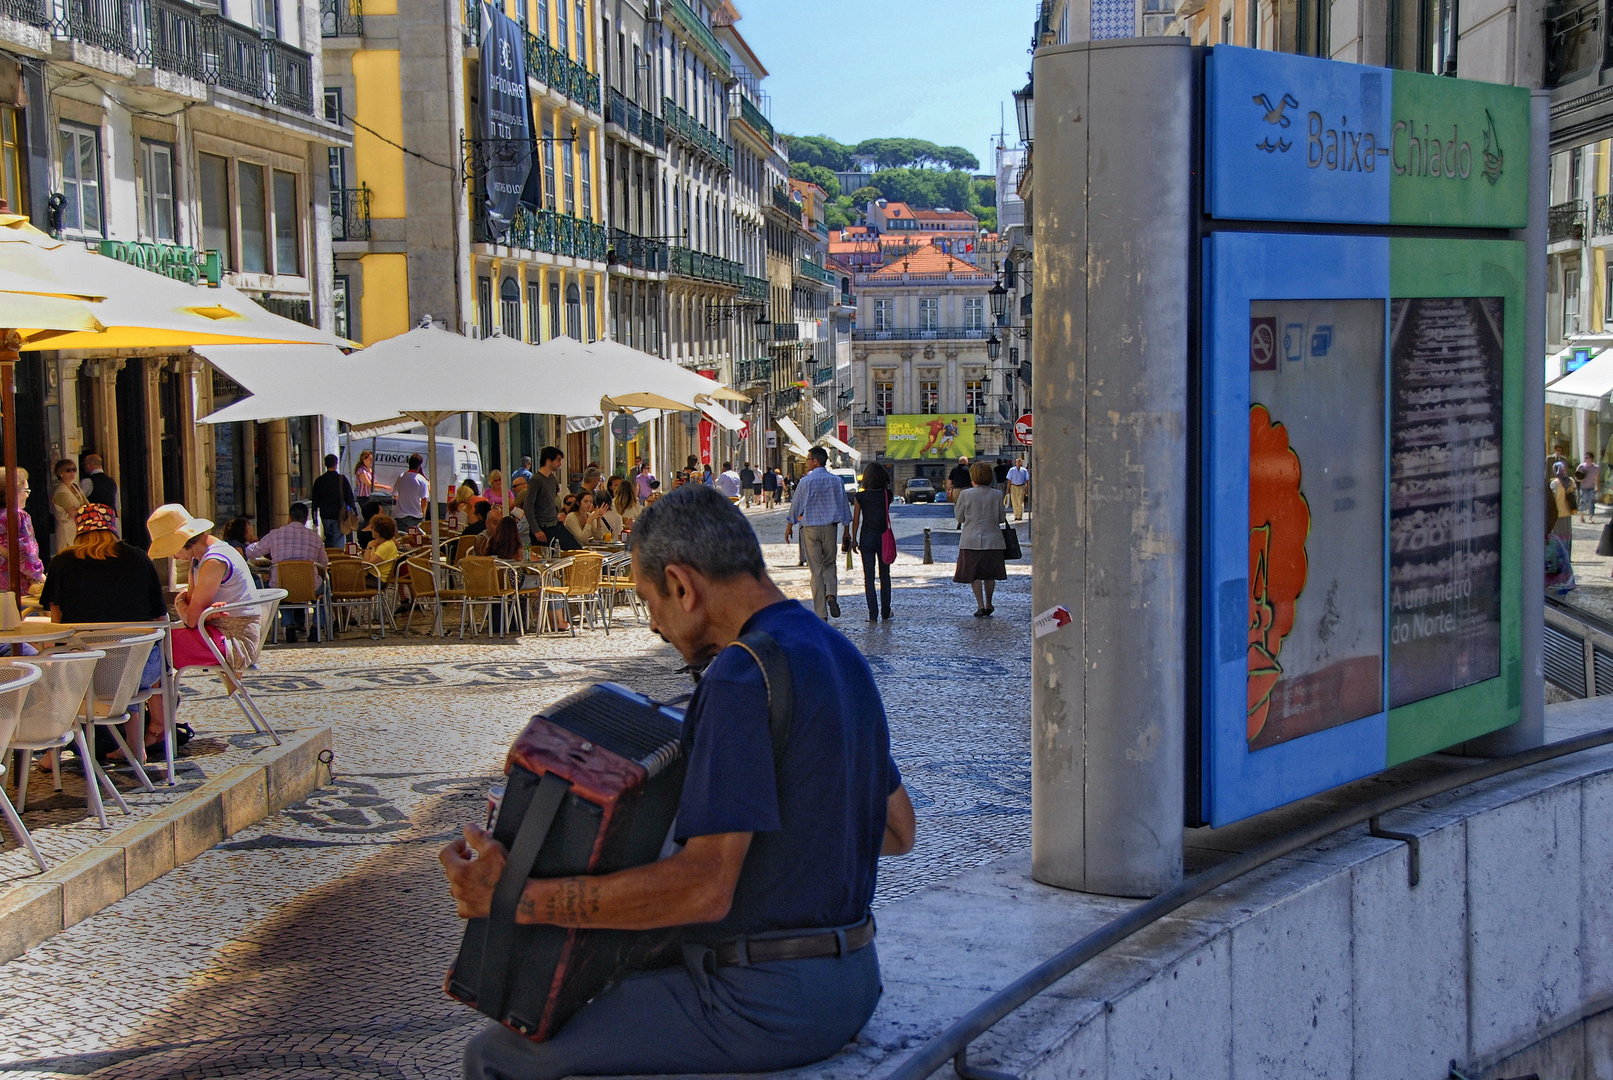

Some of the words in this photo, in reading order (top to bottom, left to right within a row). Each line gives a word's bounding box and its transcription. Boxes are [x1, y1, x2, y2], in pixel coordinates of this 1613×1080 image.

[1307, 111, 1472, 179] Baixa-Chiado
[1392, 585, 1402, 612] A
[1405, 587, 1429, 609] um
[1432, 577, 1472, 604] metro
[1391, 616, 1409, 645] do
